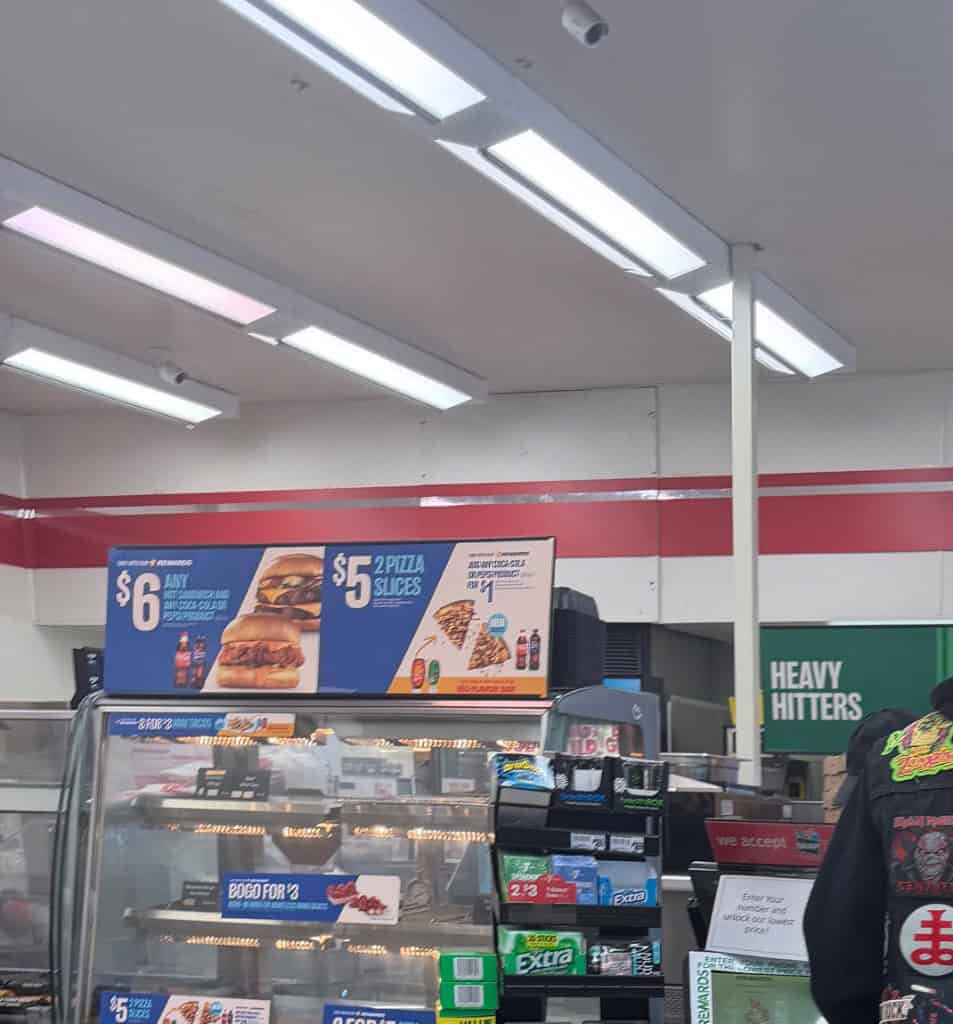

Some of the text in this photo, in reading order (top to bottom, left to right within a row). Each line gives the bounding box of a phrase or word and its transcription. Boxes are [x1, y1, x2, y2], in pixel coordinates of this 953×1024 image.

[332, 552, 425, 609] $5 2 PIZZA
[373, 576, 422, 597] SLICES
[480, 580, 494, 603] $1
[115, 570, 190, 632] $6 ANY
[769, 660, 843, 690] HEAVY
[771, 692, 863, 721] HITTERS
[717, 836, 787, 849] we accept
[262, 882, 285, 900] FOR
[614, 889, 647, 904] Extra
[742, 892, 764, 902] Enter
[736, 904, 787, 914] number and
[723, 914, 747, 925] unlock
[767, 916, 795, 927] lowest
[516, 949, 573, 974] Extra
[110, 995, 128, 1024] $5
